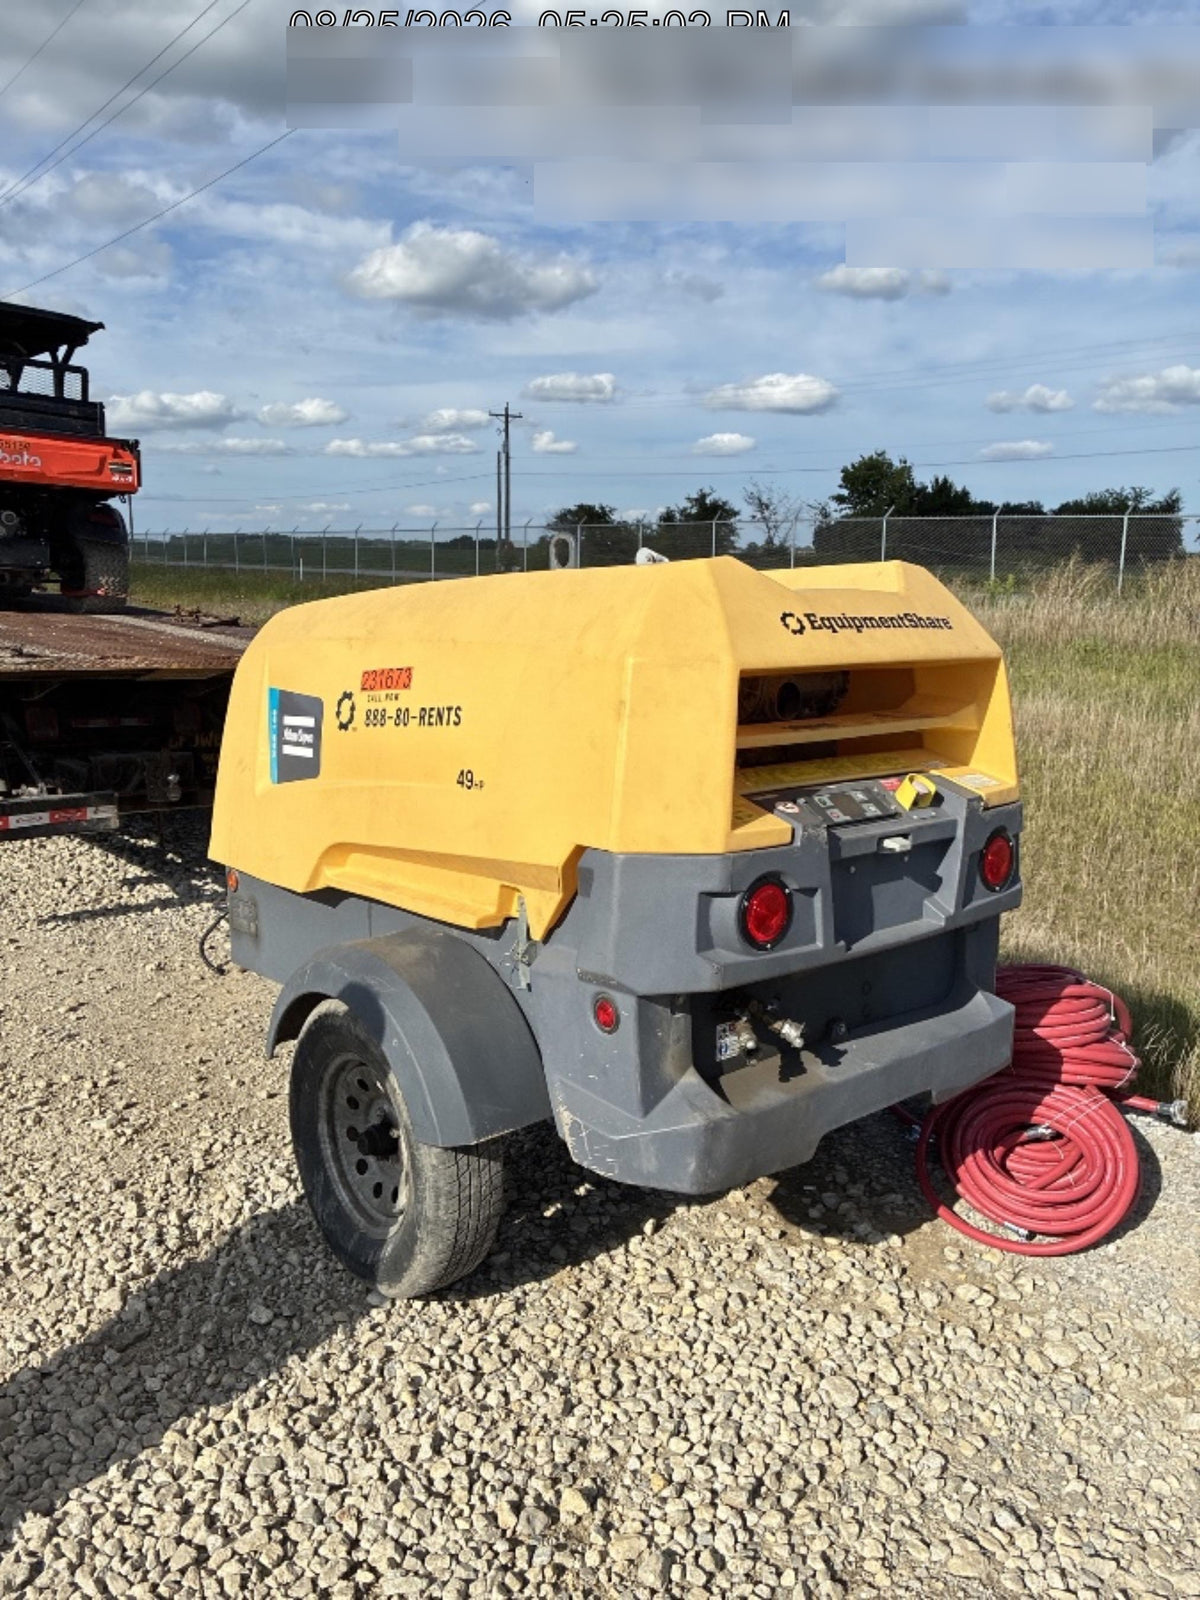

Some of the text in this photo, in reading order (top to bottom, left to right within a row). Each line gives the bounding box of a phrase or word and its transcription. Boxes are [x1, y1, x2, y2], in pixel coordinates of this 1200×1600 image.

[803, 613, 953, 633] EquipmentShare
[361, 667, 412, 690] 231673
[364, 706, 463, 727] 888-80-RENTS
